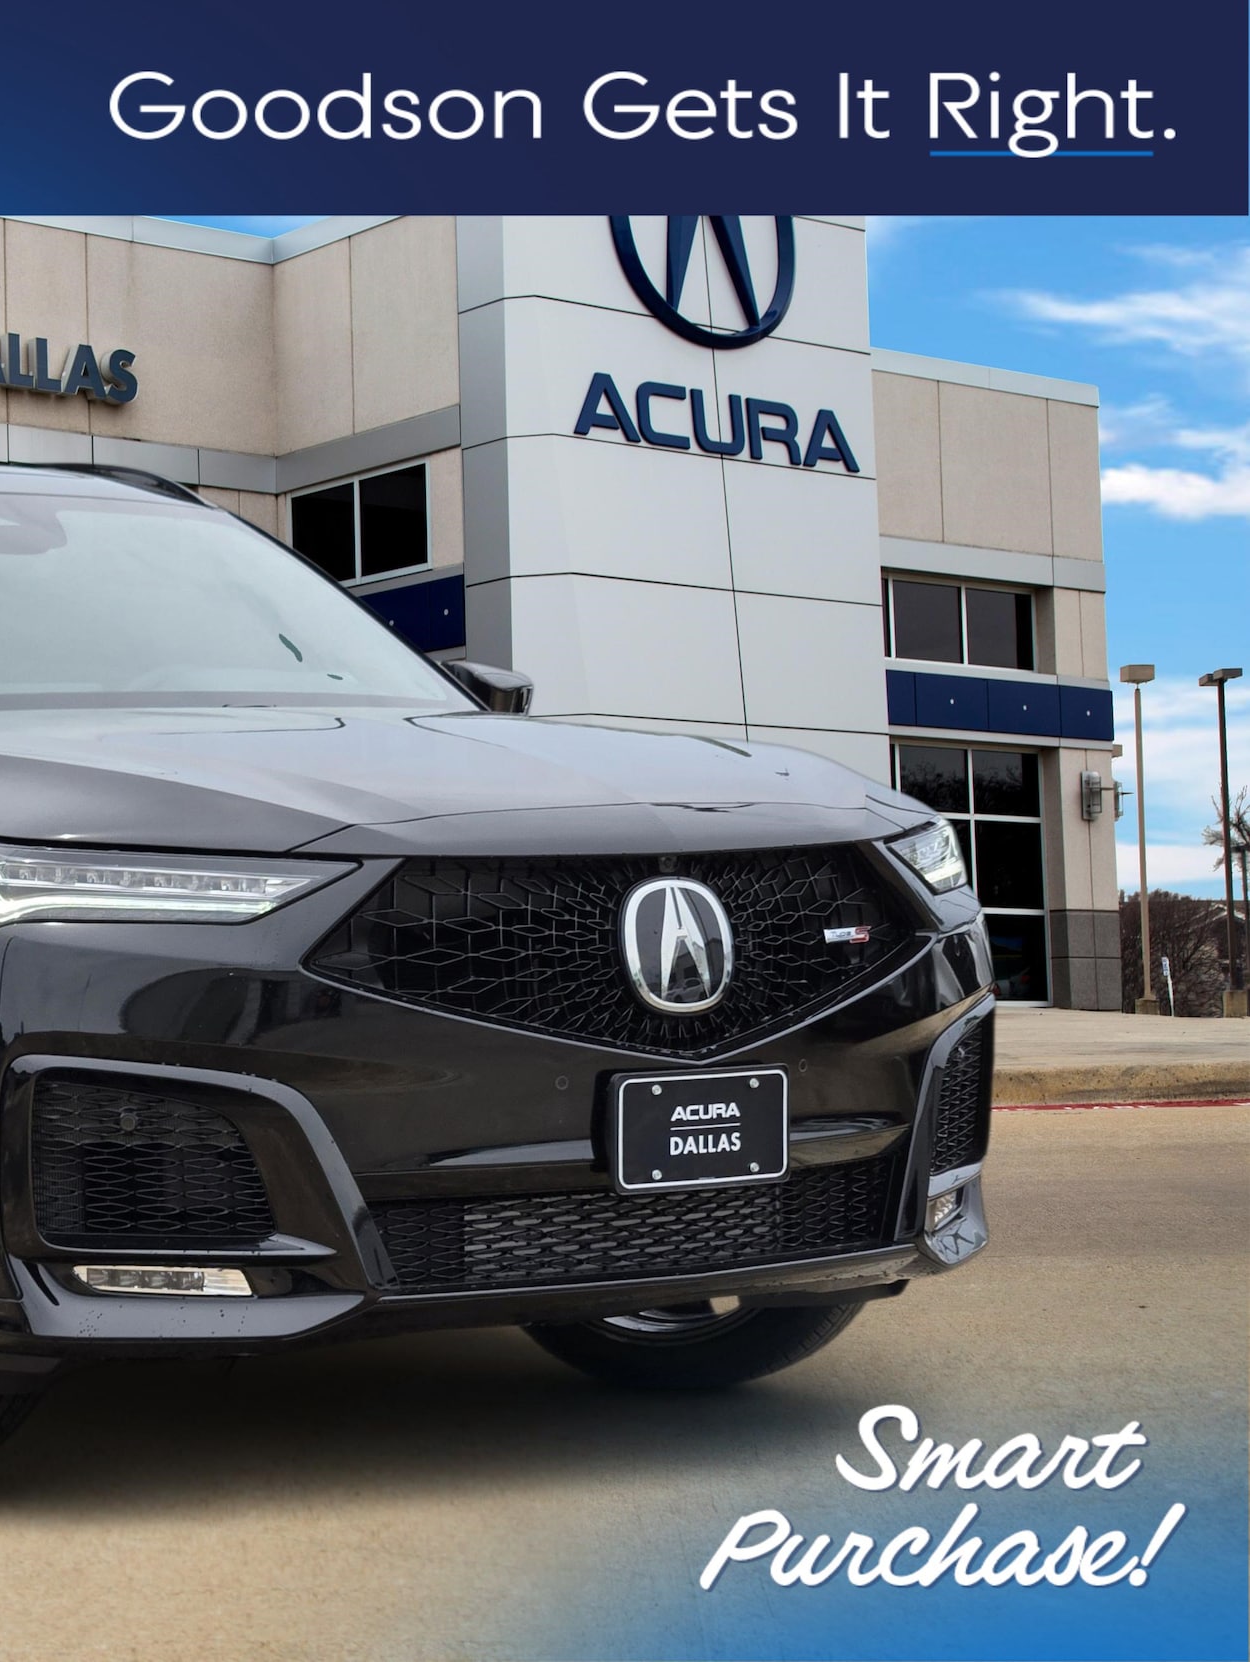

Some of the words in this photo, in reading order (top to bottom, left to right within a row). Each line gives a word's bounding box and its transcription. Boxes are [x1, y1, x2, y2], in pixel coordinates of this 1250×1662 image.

[574, 372, 862, 475] ACURA
[669, 1101, 742, 1122] ACURA
[668, 1131, 742, 1156] DALLAS
